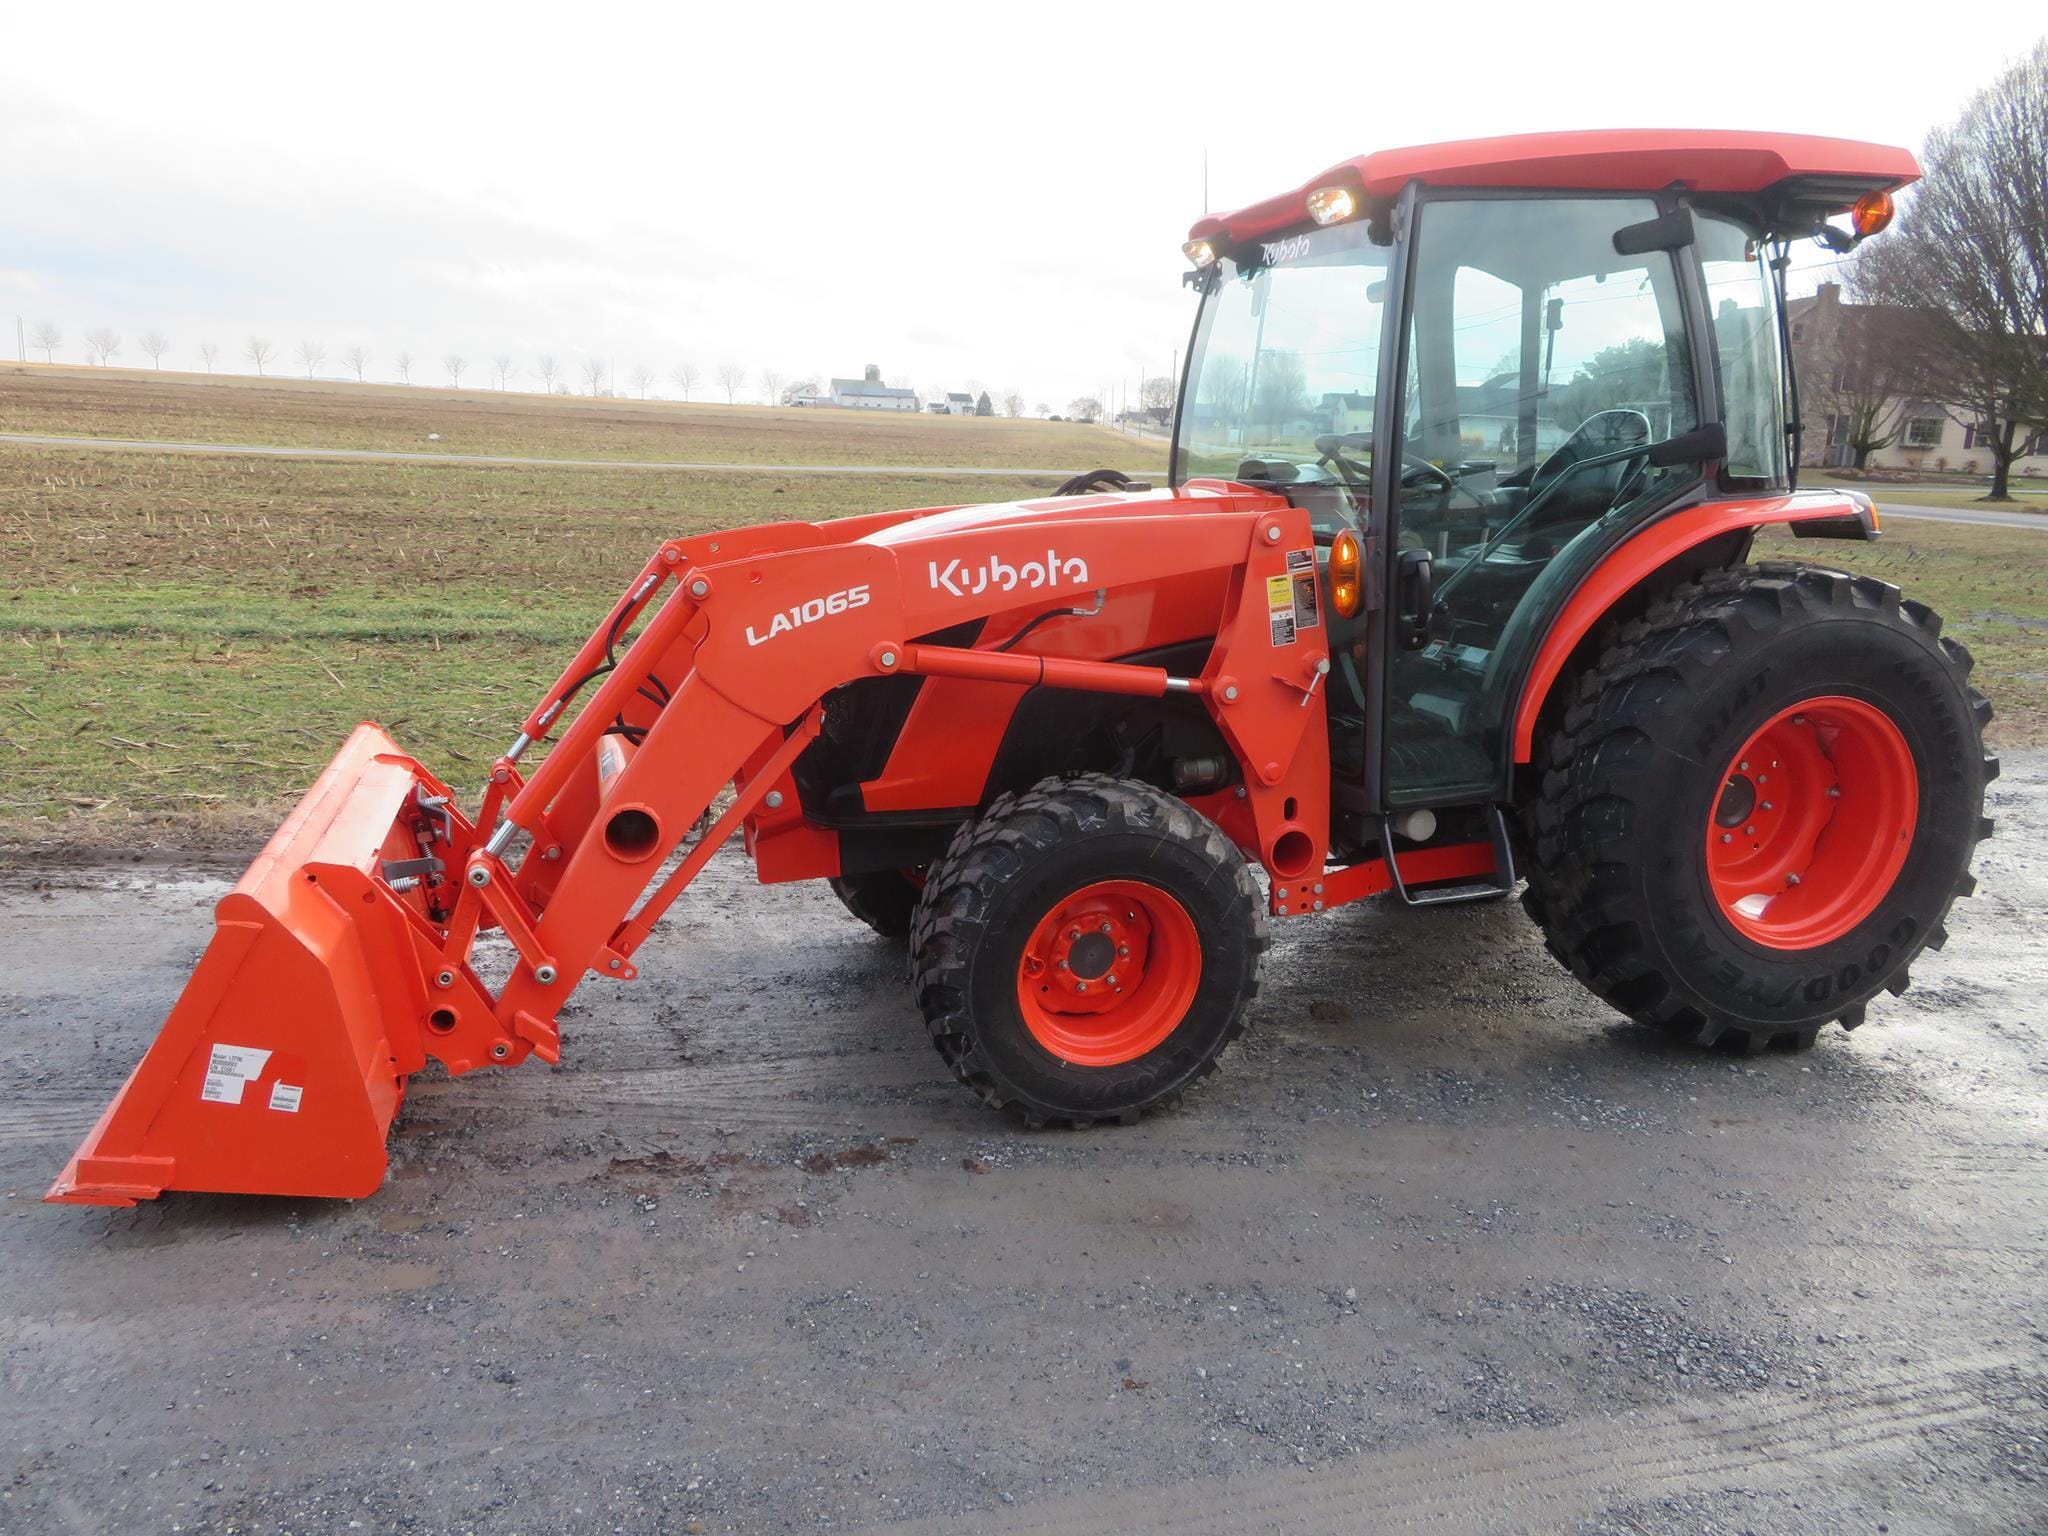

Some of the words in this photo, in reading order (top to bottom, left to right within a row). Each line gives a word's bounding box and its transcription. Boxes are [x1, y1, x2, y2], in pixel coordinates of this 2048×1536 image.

[1262, 234, 1310, 266] Kubota
[928, 549, 1089, 597] Kubota
[745, 584, 870, 647] LA1065
